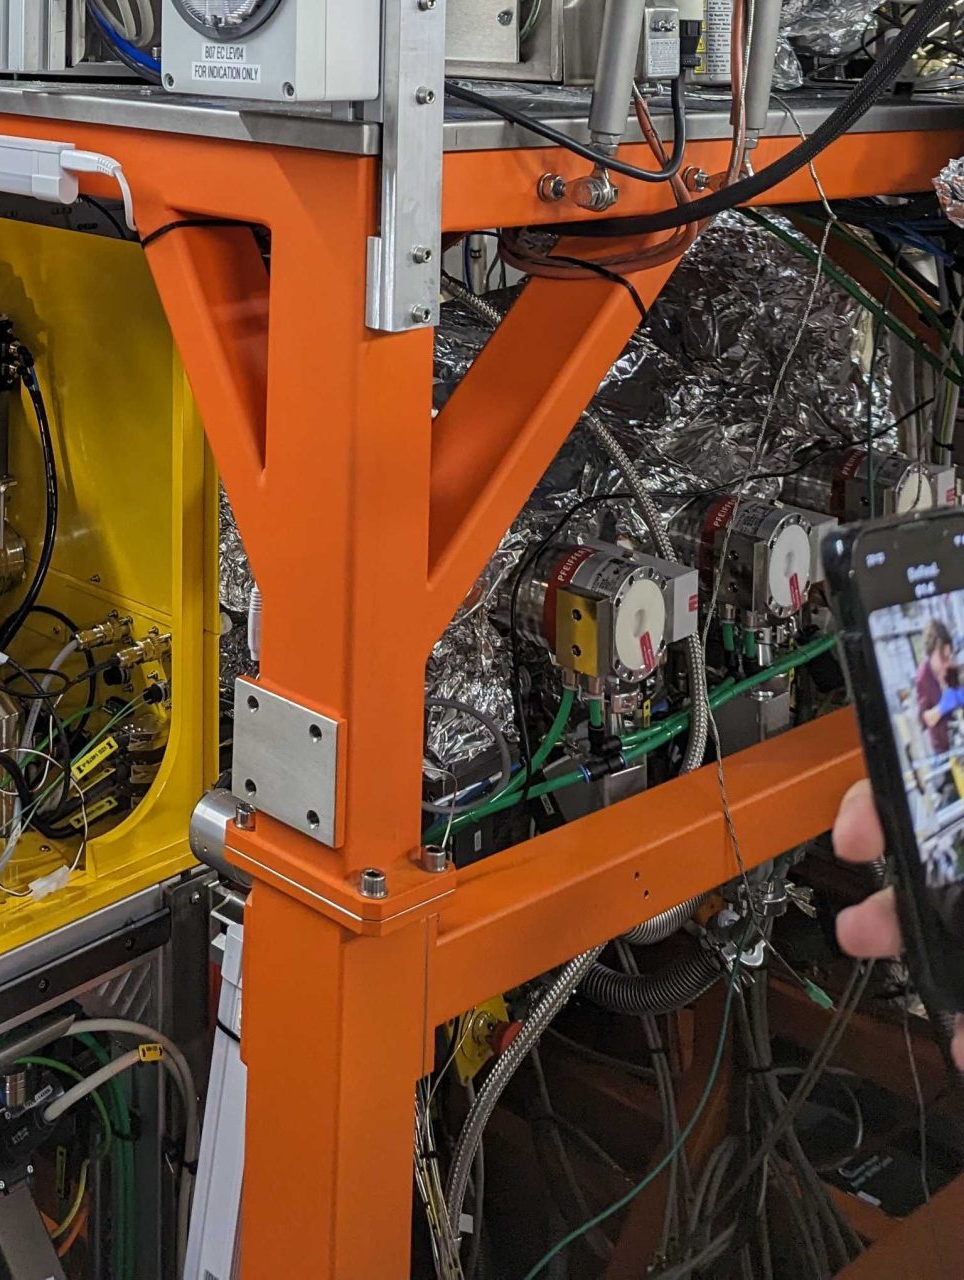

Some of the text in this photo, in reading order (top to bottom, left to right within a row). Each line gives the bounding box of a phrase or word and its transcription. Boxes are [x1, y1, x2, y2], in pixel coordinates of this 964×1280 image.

[204, 45, 216, 59] B07
[216, 46, 225, 60] EC
[194, 64, 259, 81] FOR INDICATION ONLY
